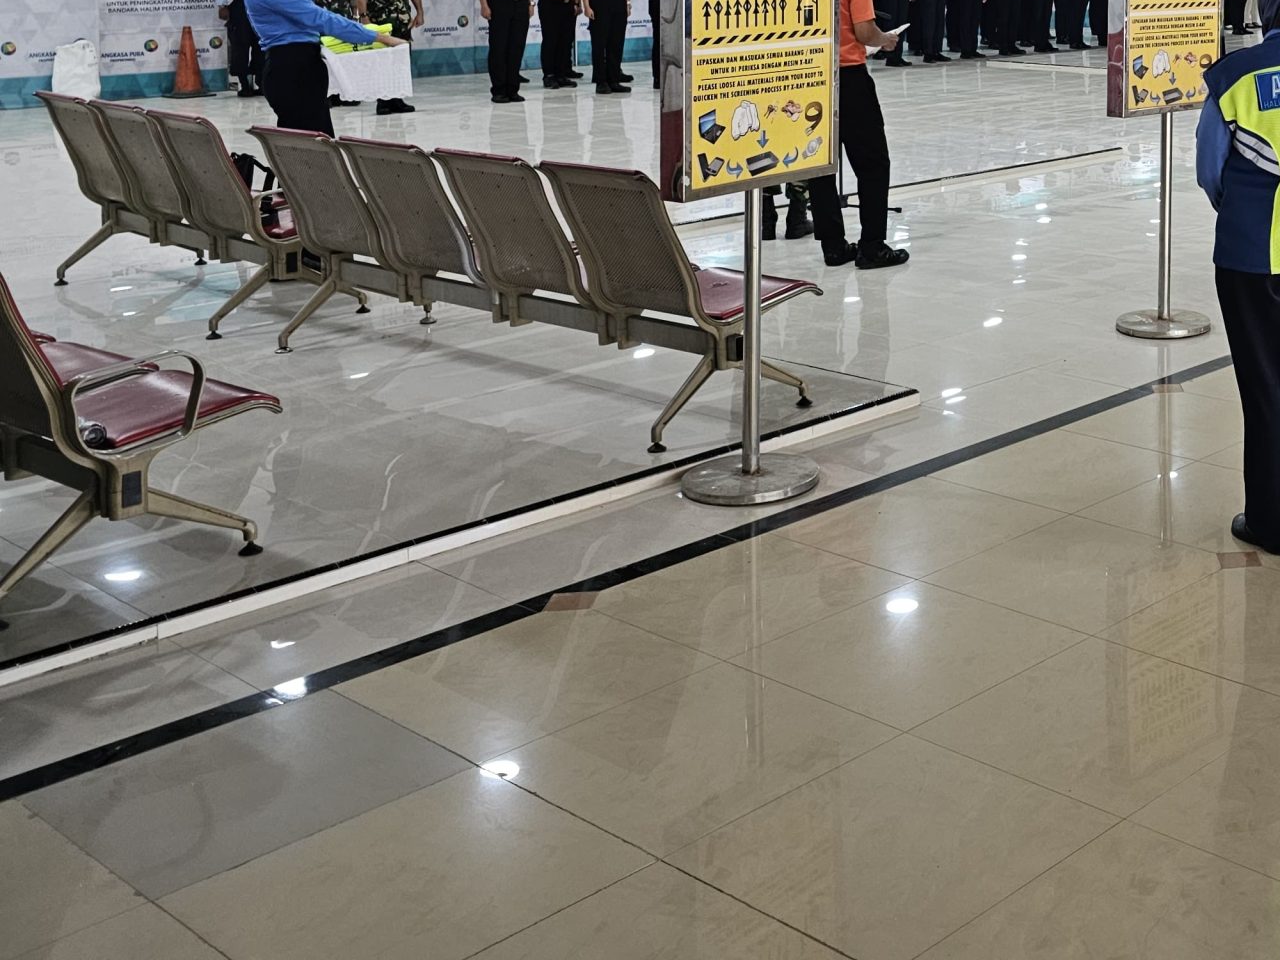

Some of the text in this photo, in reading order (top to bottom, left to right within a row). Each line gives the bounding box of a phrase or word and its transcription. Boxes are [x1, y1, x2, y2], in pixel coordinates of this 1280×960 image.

[696, 57, 725, 66] LEPASKAN
[740, 54, 765, 62] MASUKAN
[784, 49, 804, 57] BARANG
[809, 47, 824, 55] BENDA
[710, 67, 729, 75] UNTUK
[738, 64, 760, 72] PERIKSA
[761, 62, 782, 70] DENGAN
[693, 93, 718, 102] QUICKEN
[730, 88, 760, 97] SCREENING
[761, 85, 782, 94] PROCESS
[783, 83, 790, 91] BY
[791, 81, 805, 89] X-RAY
[806, 79, 827, 88] MACHINE
[697, 83, 717, 91] PLEASE
[719, 81, 735, 89] LOOSE
[747, 76, 774, 86] MATERIALS
